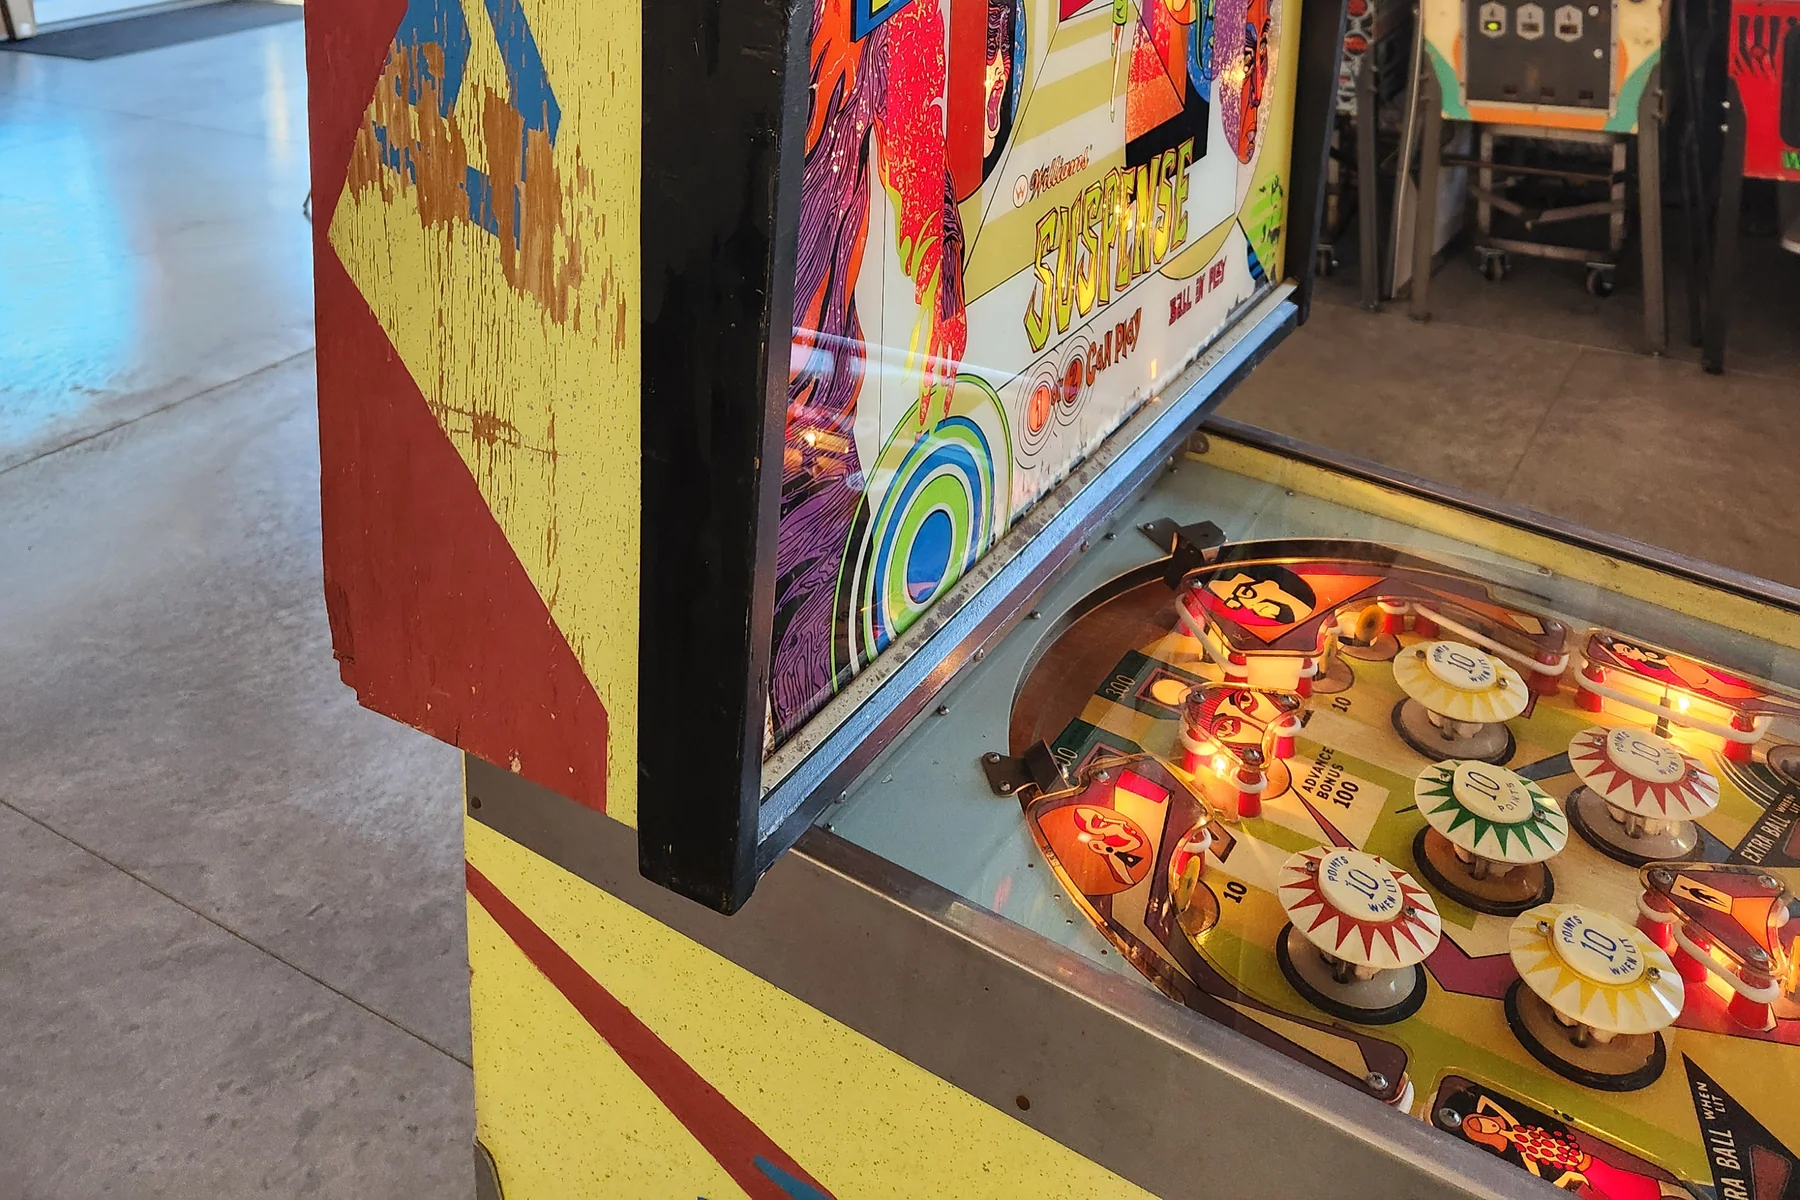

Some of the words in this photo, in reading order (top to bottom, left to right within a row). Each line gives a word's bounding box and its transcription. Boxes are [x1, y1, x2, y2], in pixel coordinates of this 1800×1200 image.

[1029, 146, 1089, 203] Williams
[1023, 136, 1195, 353] SUSPENSE
[1447, 652, 1475, 674] 10
[1105, 674, 1136, 699] 300
[1332, 696, 1351, 712] 10
[1631, 741, 1660, 765] 10
[1301, 746, 1334, 793] ADVANCE
[1316, 763, 1344, 800] BONUS
[1333, 781, 1359, 809] 100
[1465, 771, 1500, 801] 10
[1497, 782, 1520, 812] POINTS
[1740, 834, 1775, 863] EXTRA
[1760, 814, 1791, 838] BALL
[1776, 793, 1796, 813] WHEN
[1327, 856, 1349, 882] POINTS
[1344, 869, 1379, 899] 10
[1223, 881, 1248, 904] 10
[1368, 895, 1396, 913] WHEN
[1382, 878, 1397, 893] LIT
[1562, 915, 1582, 943] POINTS
[1580, 928, 1616, 962] 10
[1619, 938, 1636, 953] LIT
[1609, 956, 1637, 975] WHEN
[1696, 1081, 1716, 1120] WHEN
[1711, 1094, 1726, 1113] LIT
[1708, 1129, 1741, 1171] BALL
